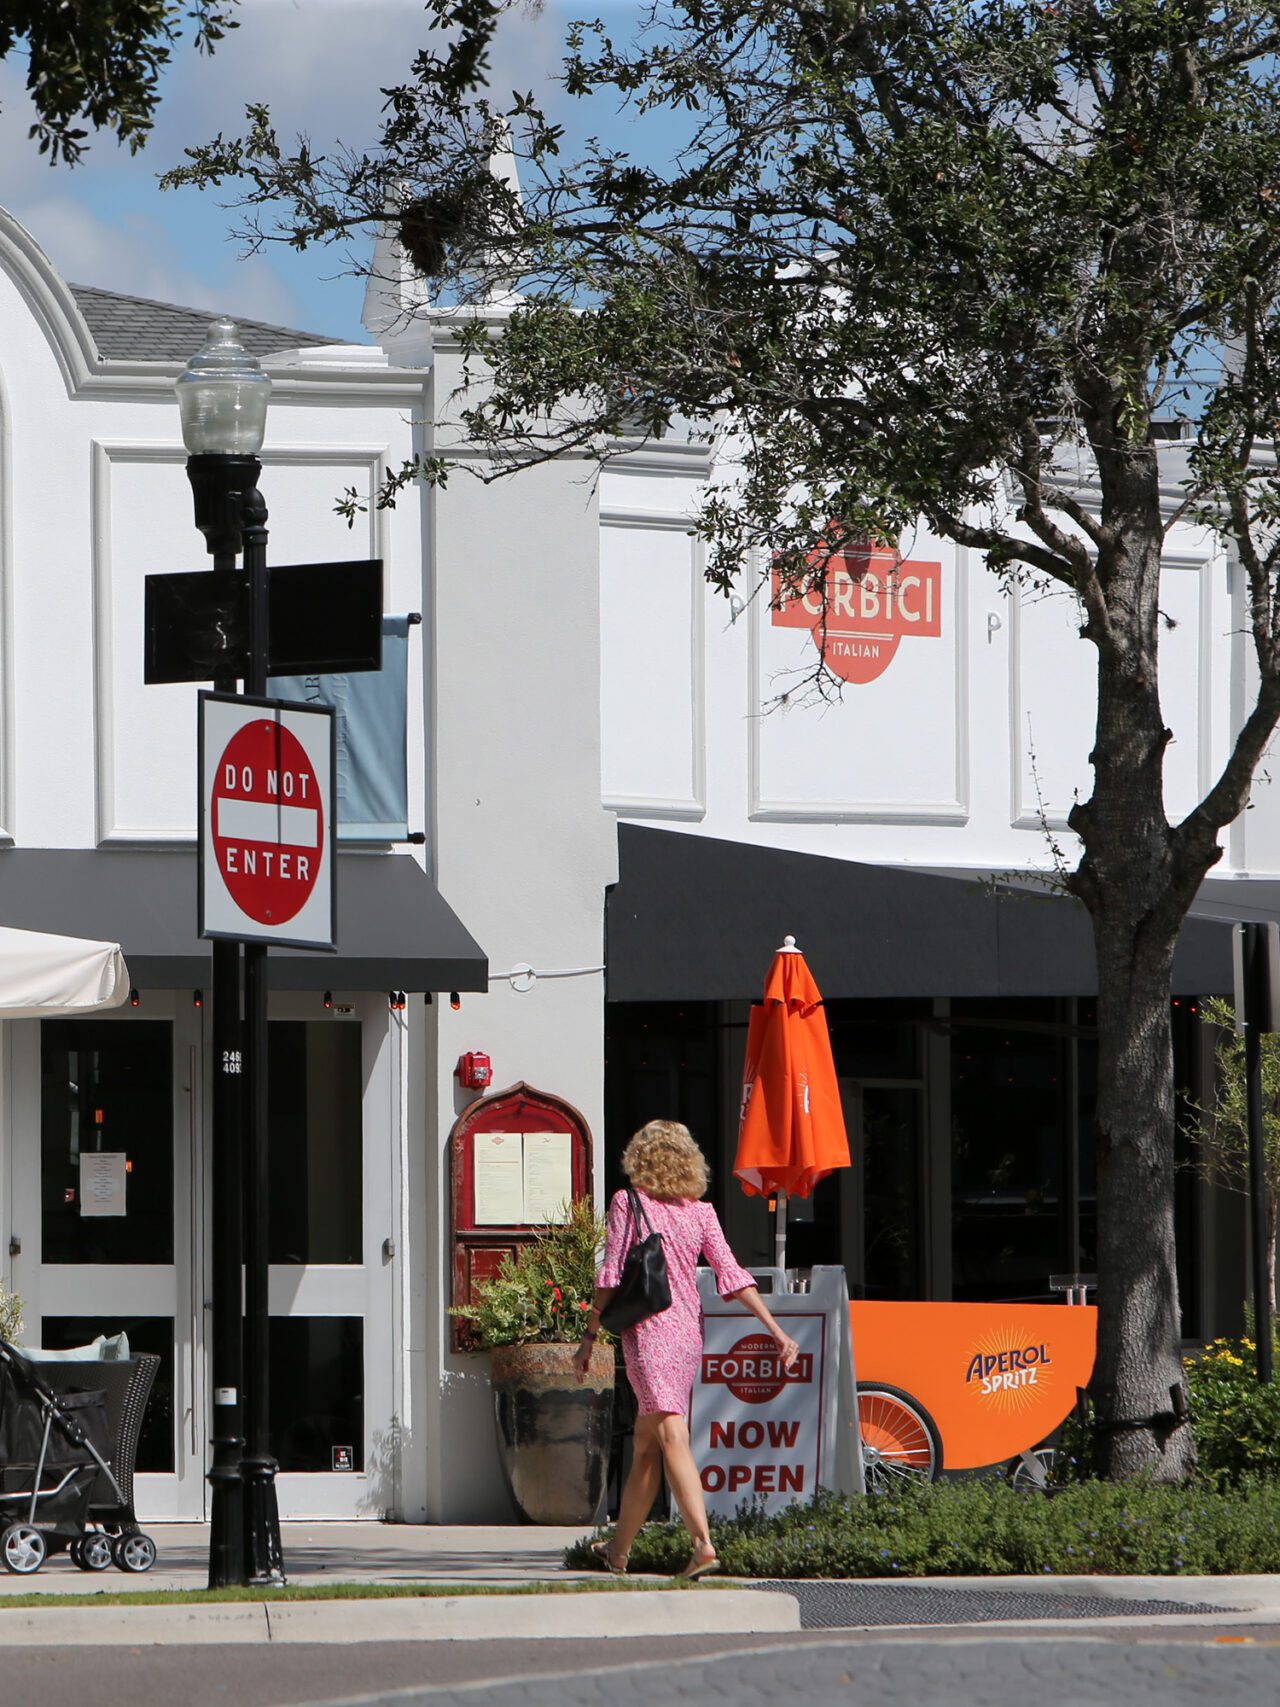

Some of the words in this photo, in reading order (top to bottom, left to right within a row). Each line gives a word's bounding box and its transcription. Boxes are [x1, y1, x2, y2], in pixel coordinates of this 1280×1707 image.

[832, 642, 880, 658] ITALIAN
[225, 764, 253, 792] DO
[267, 769, 309, 799] NOT
[227, 847, 309, 881] ENTER
[706, 1359, 808, 1379] FORBICI
[966, 1344, 1051, 1383] APEROL
[741, 1386, 771, 1394] ITALIAN
[709, 1420, 801, 1449] NOW
[700, 1464, 805, 1493] OPEN
